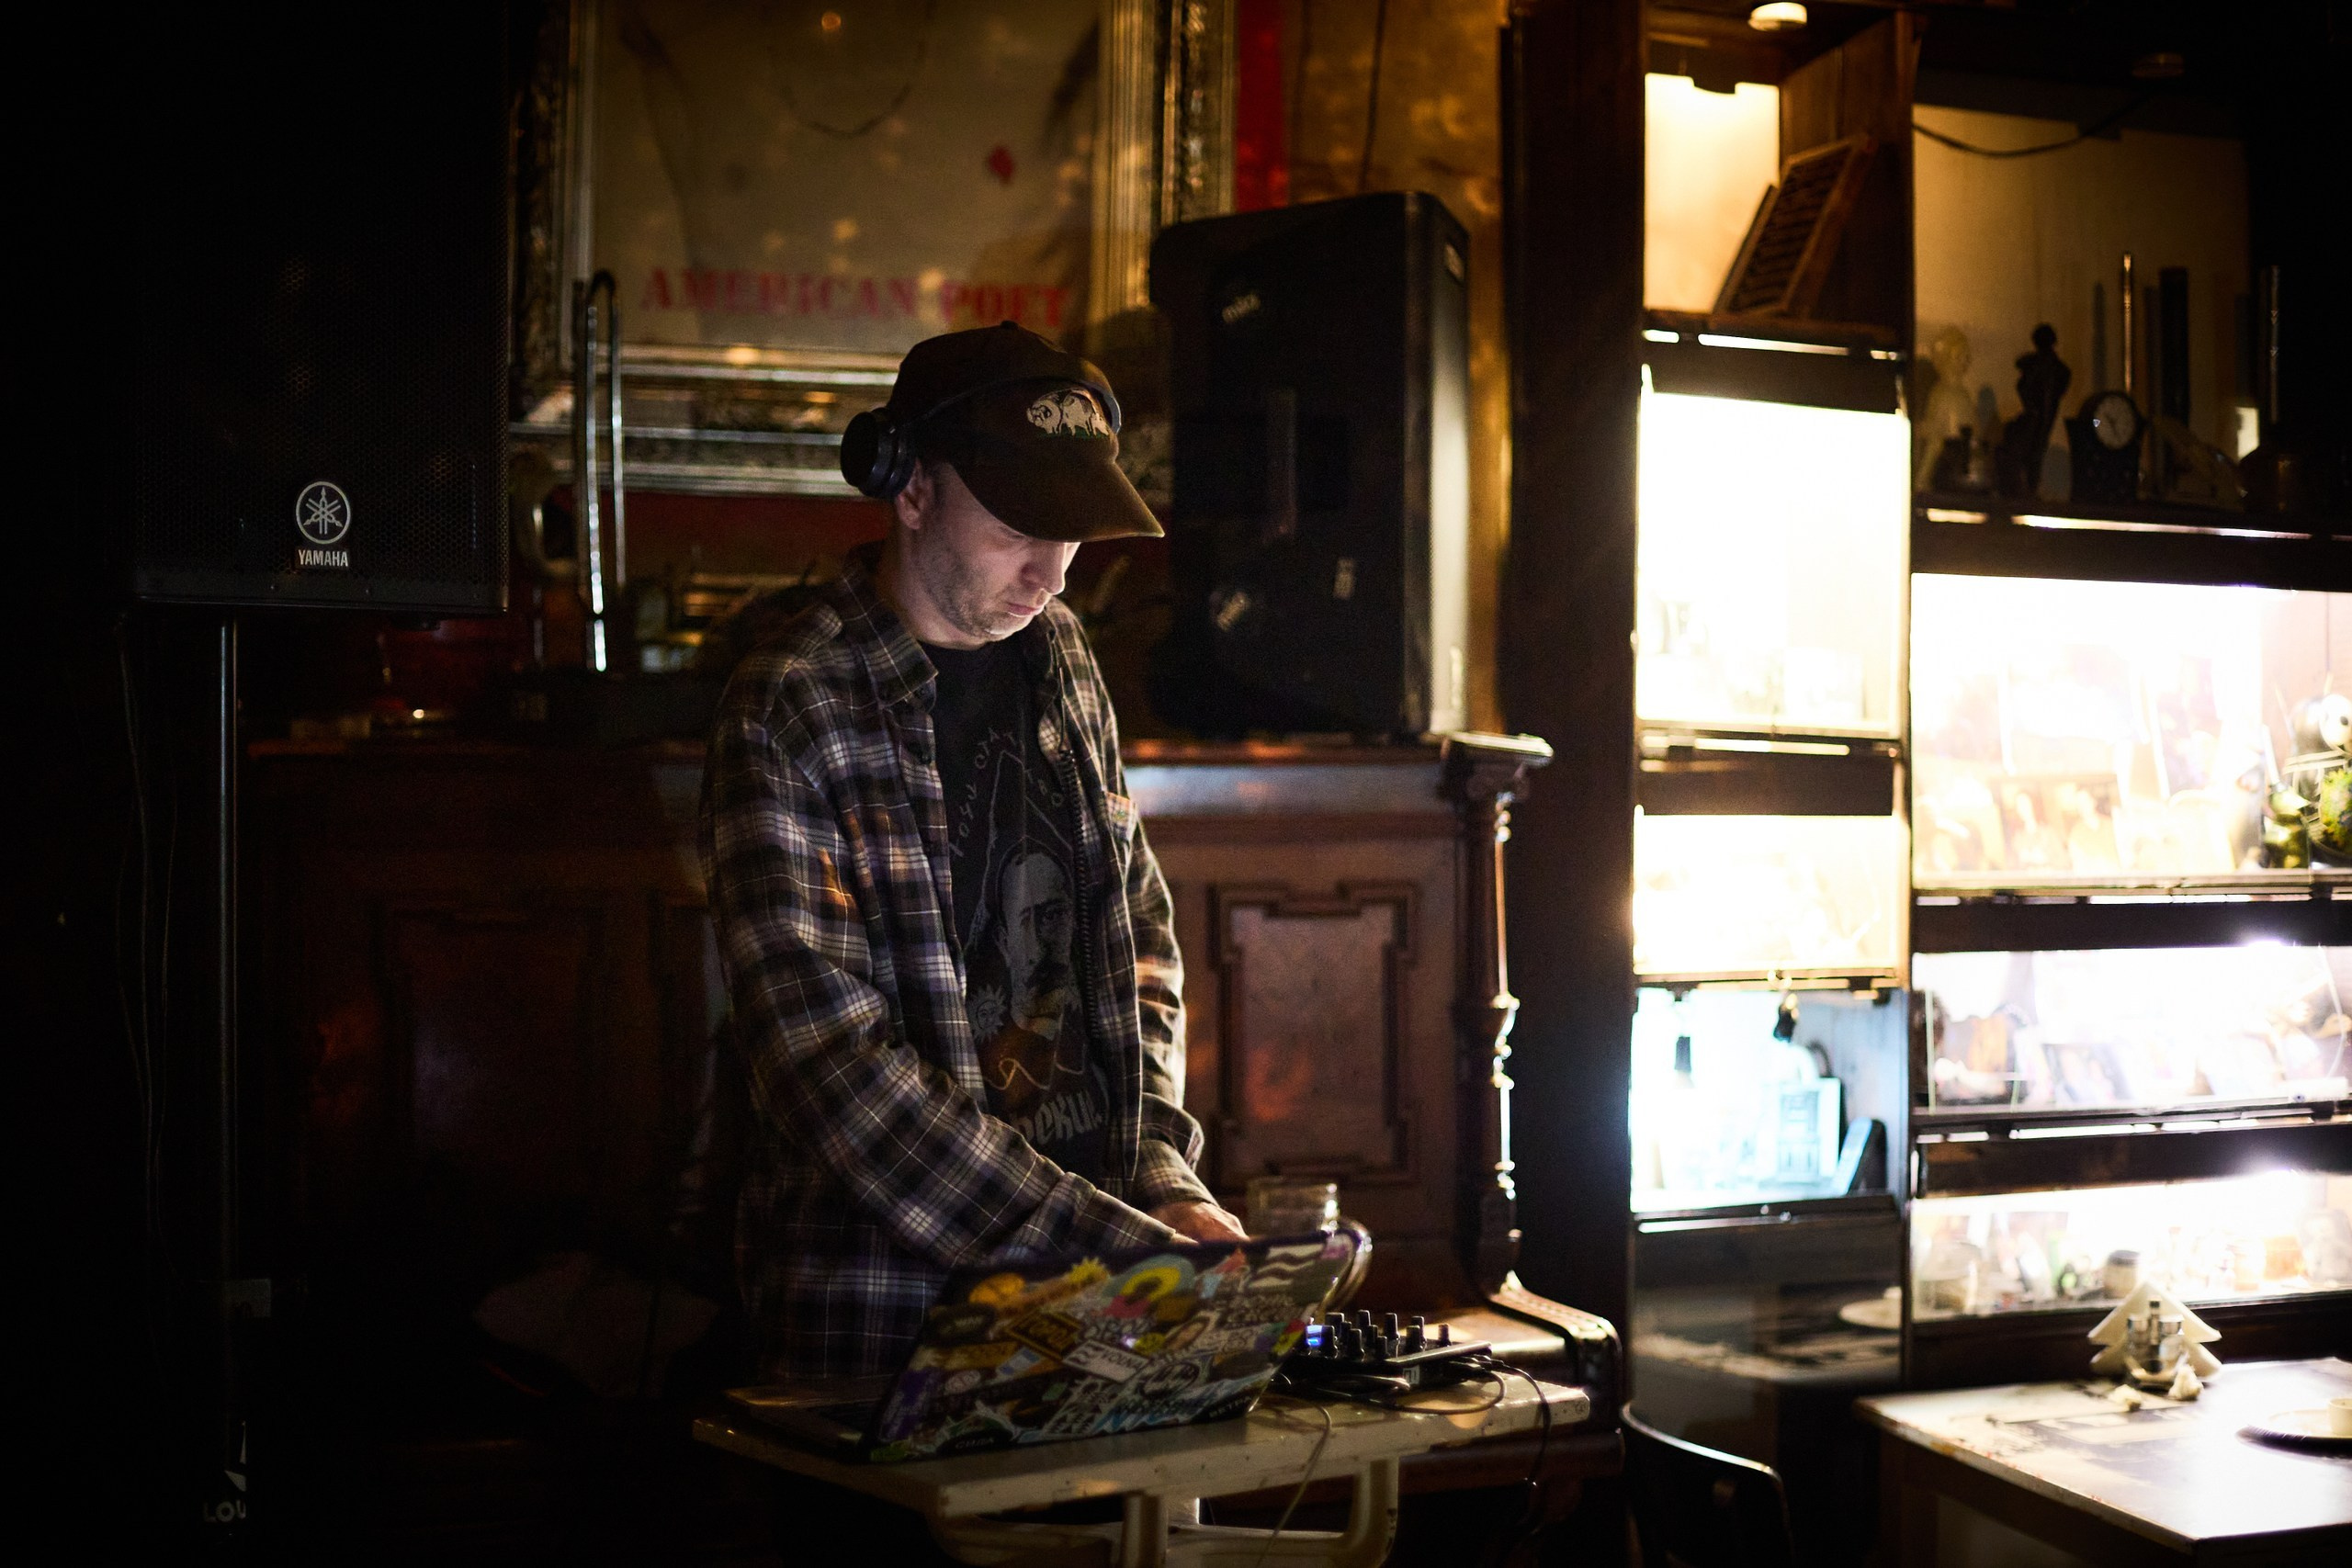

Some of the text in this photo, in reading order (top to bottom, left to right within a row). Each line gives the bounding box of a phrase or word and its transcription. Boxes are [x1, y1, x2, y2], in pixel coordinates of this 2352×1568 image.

[644, 267, 1071, 327] AMERICAN POET
[298, 549, 349, 568] YAMAHA
